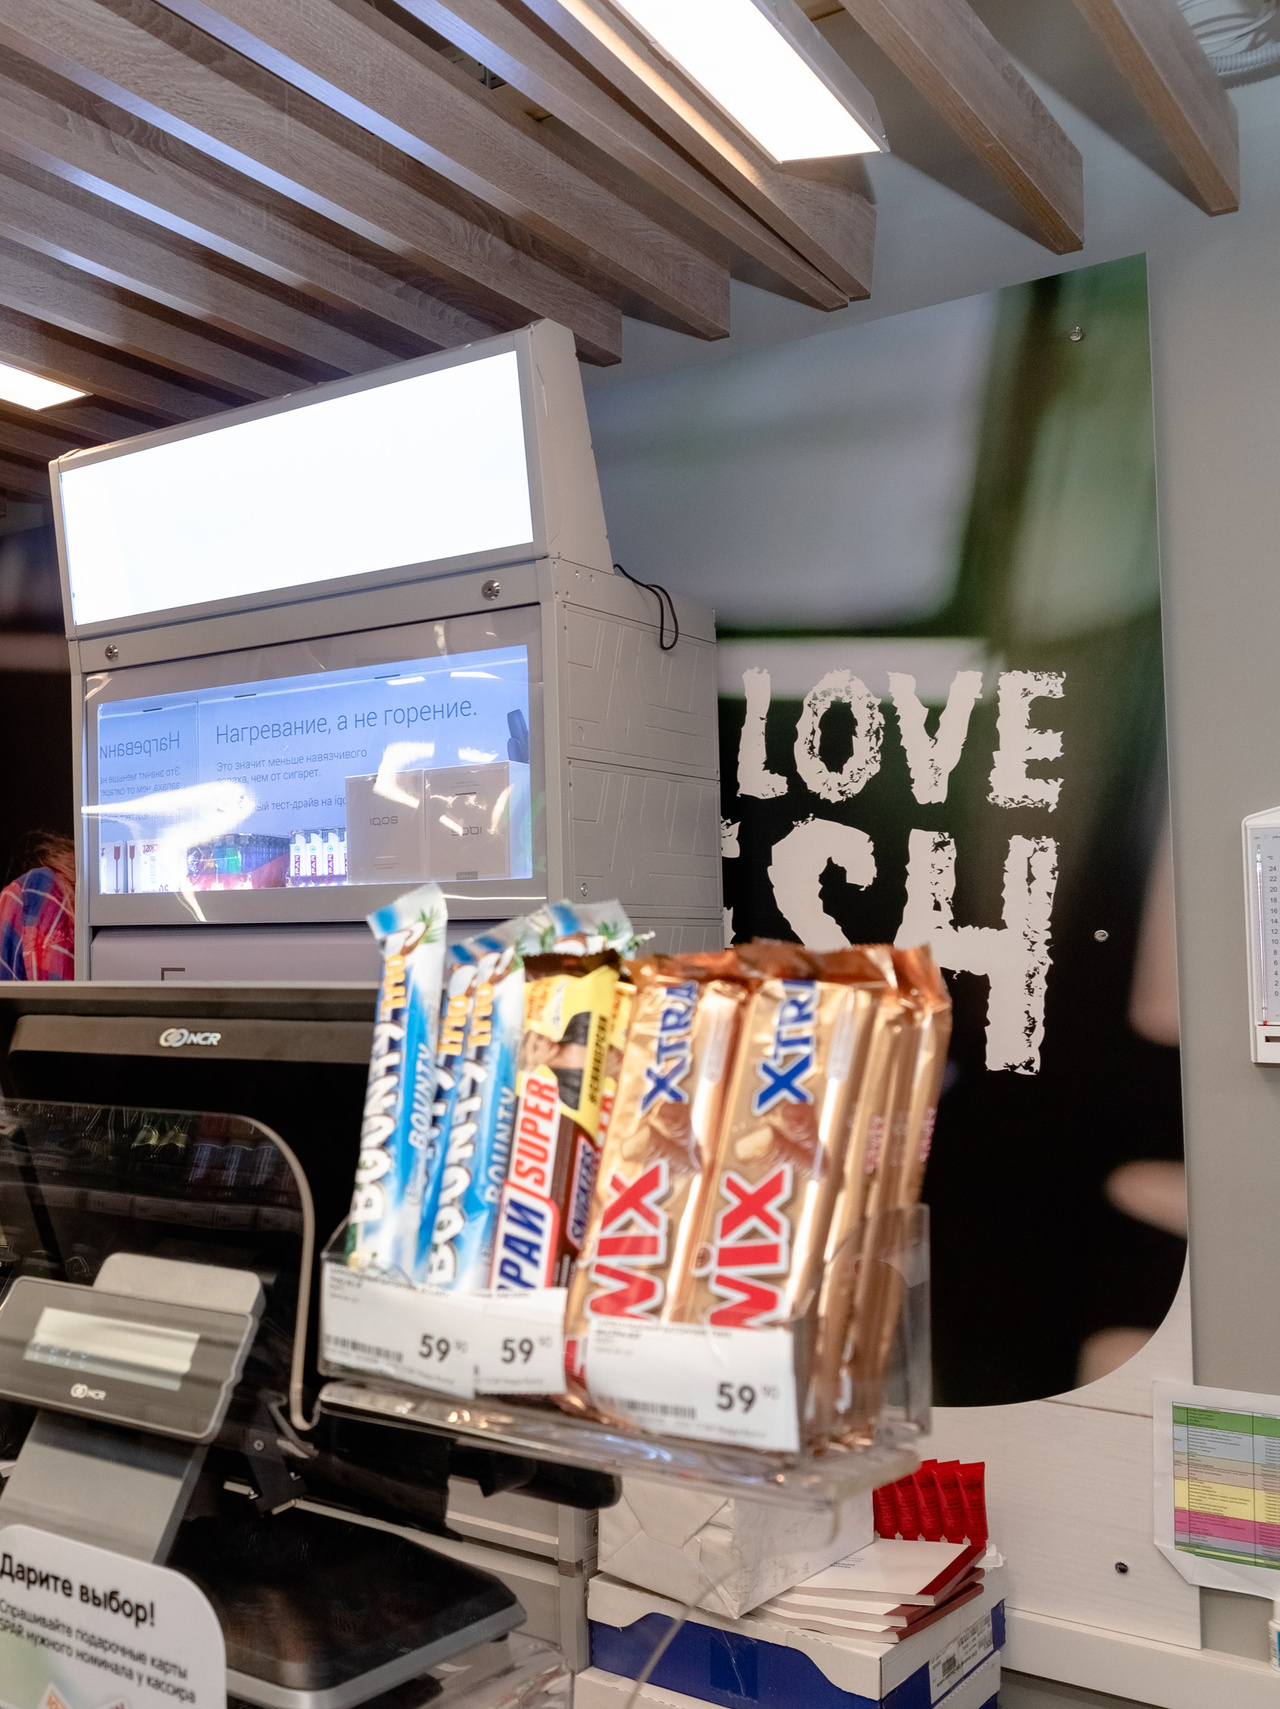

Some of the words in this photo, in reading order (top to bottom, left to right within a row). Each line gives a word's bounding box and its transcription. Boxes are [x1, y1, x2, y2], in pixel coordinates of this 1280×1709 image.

[216, 718, 331, 746] Нагревание,
[337, 715, 348, 730] а
[354, 711, 378, 728] не
[384, 700, 477, 728] горение.
[736, 667, 1067, 813] LOVE
[217, 761, 232, 773] Это
[235, 758, 266, 772] значит
[268, 755, 304, 769] меньше
[306, 749, 368, 764] навязчивого
[251, 774, 268, 784] чем
[270, 772, 285, 782] от
[287, 768, 321, 784] сигарет.
[271, 798, 319, 812] тест-драйв
[321, 798, 333, 807] на
[370, 816, 398, 827] IQOS
[186, 1031, 222, 1046] NCR
[353, 1022, 406, 1224] BOUNTY
[408, 1042, 432, 1150] BOUNTY
[515, 1077, 558, 1188] SUPER
[429, 1060, 488, 1285] BOUNTY
[486, 1087, 513, 1203] BOUNTY
[497, 1198, 548, 1290] РАЙ
[580, 1160, 670, 1332] WIX
[710, 1162, 794, 1330] WIX
[418, 1333, 451, 1363] 59
[501, 1337, 535, 1364] 59
[716, 1381, 757, 1414] 59
[0, 1553, 73, 1598] Дарите
[80, 1585, 156, 1629] выбор!
[26, 1631, 73, 1659] нужного
[75, 1650, 134, 1681] номинала
[146, 1676, 197, 1705] кассира
[75, 1628, 148, 1667] подарочные
[150, 1654, 189, 1680] карты
